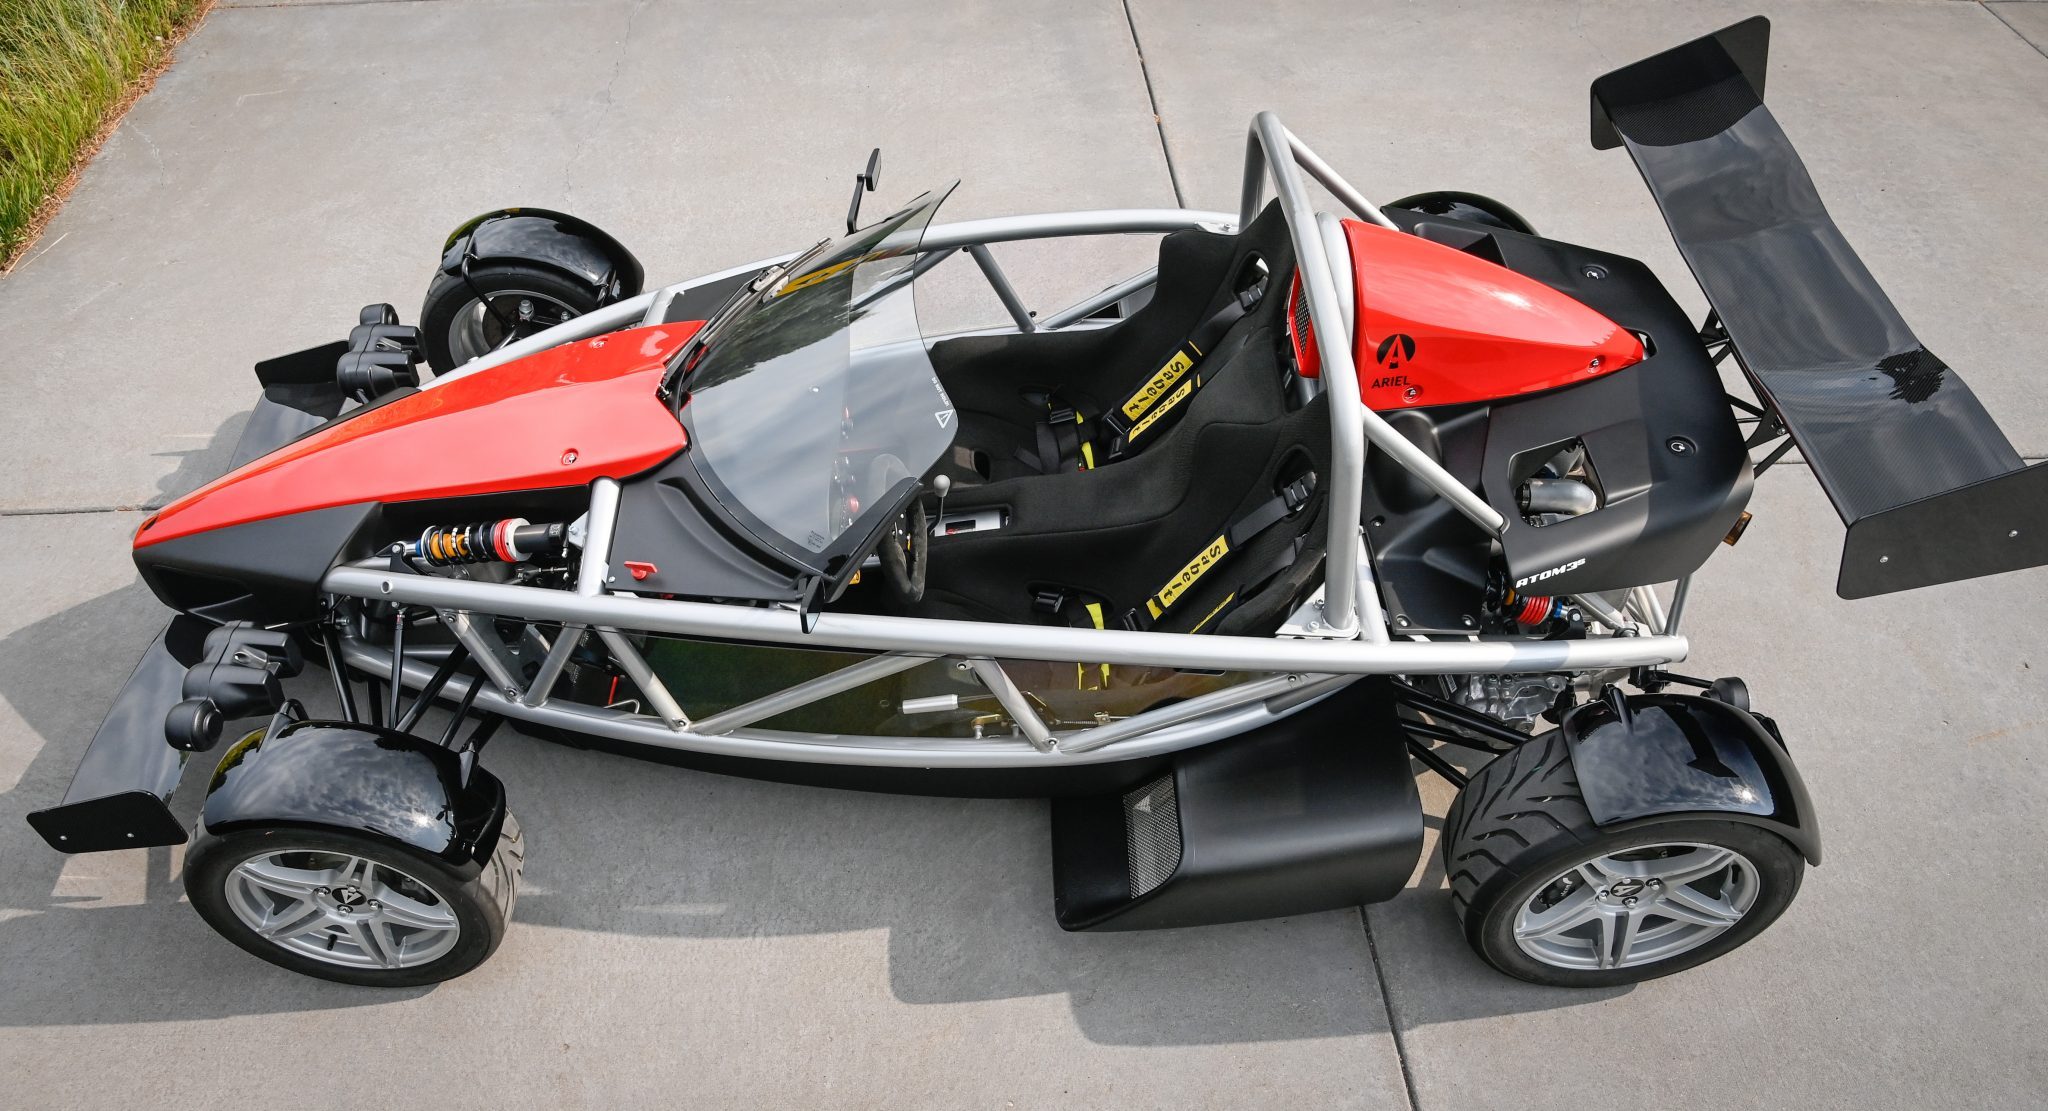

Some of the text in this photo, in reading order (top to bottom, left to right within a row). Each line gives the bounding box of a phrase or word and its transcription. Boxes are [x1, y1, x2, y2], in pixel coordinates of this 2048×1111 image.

[1128, 361, 1185, 413] Sabelt
[1371, 375, 1411, 389] ARIEL
[1163, 545, 1221, 600] Sabelt
